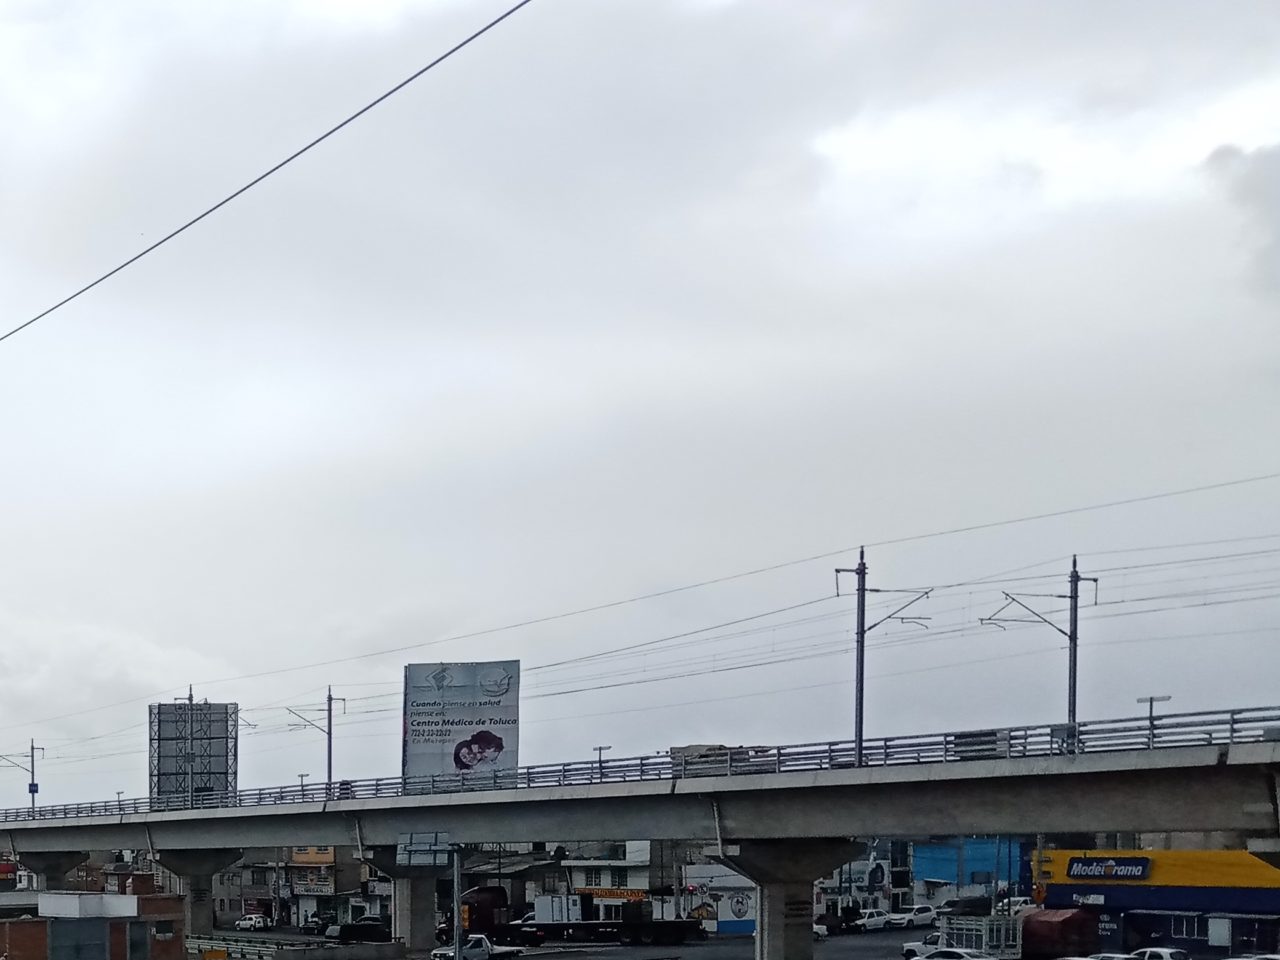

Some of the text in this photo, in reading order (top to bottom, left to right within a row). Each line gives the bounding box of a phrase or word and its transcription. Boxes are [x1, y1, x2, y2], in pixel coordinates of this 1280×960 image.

[410, 719, 440, 727] Centro
[441, 718, 474, 727] Médico
[475, 718, 487, 726] de
